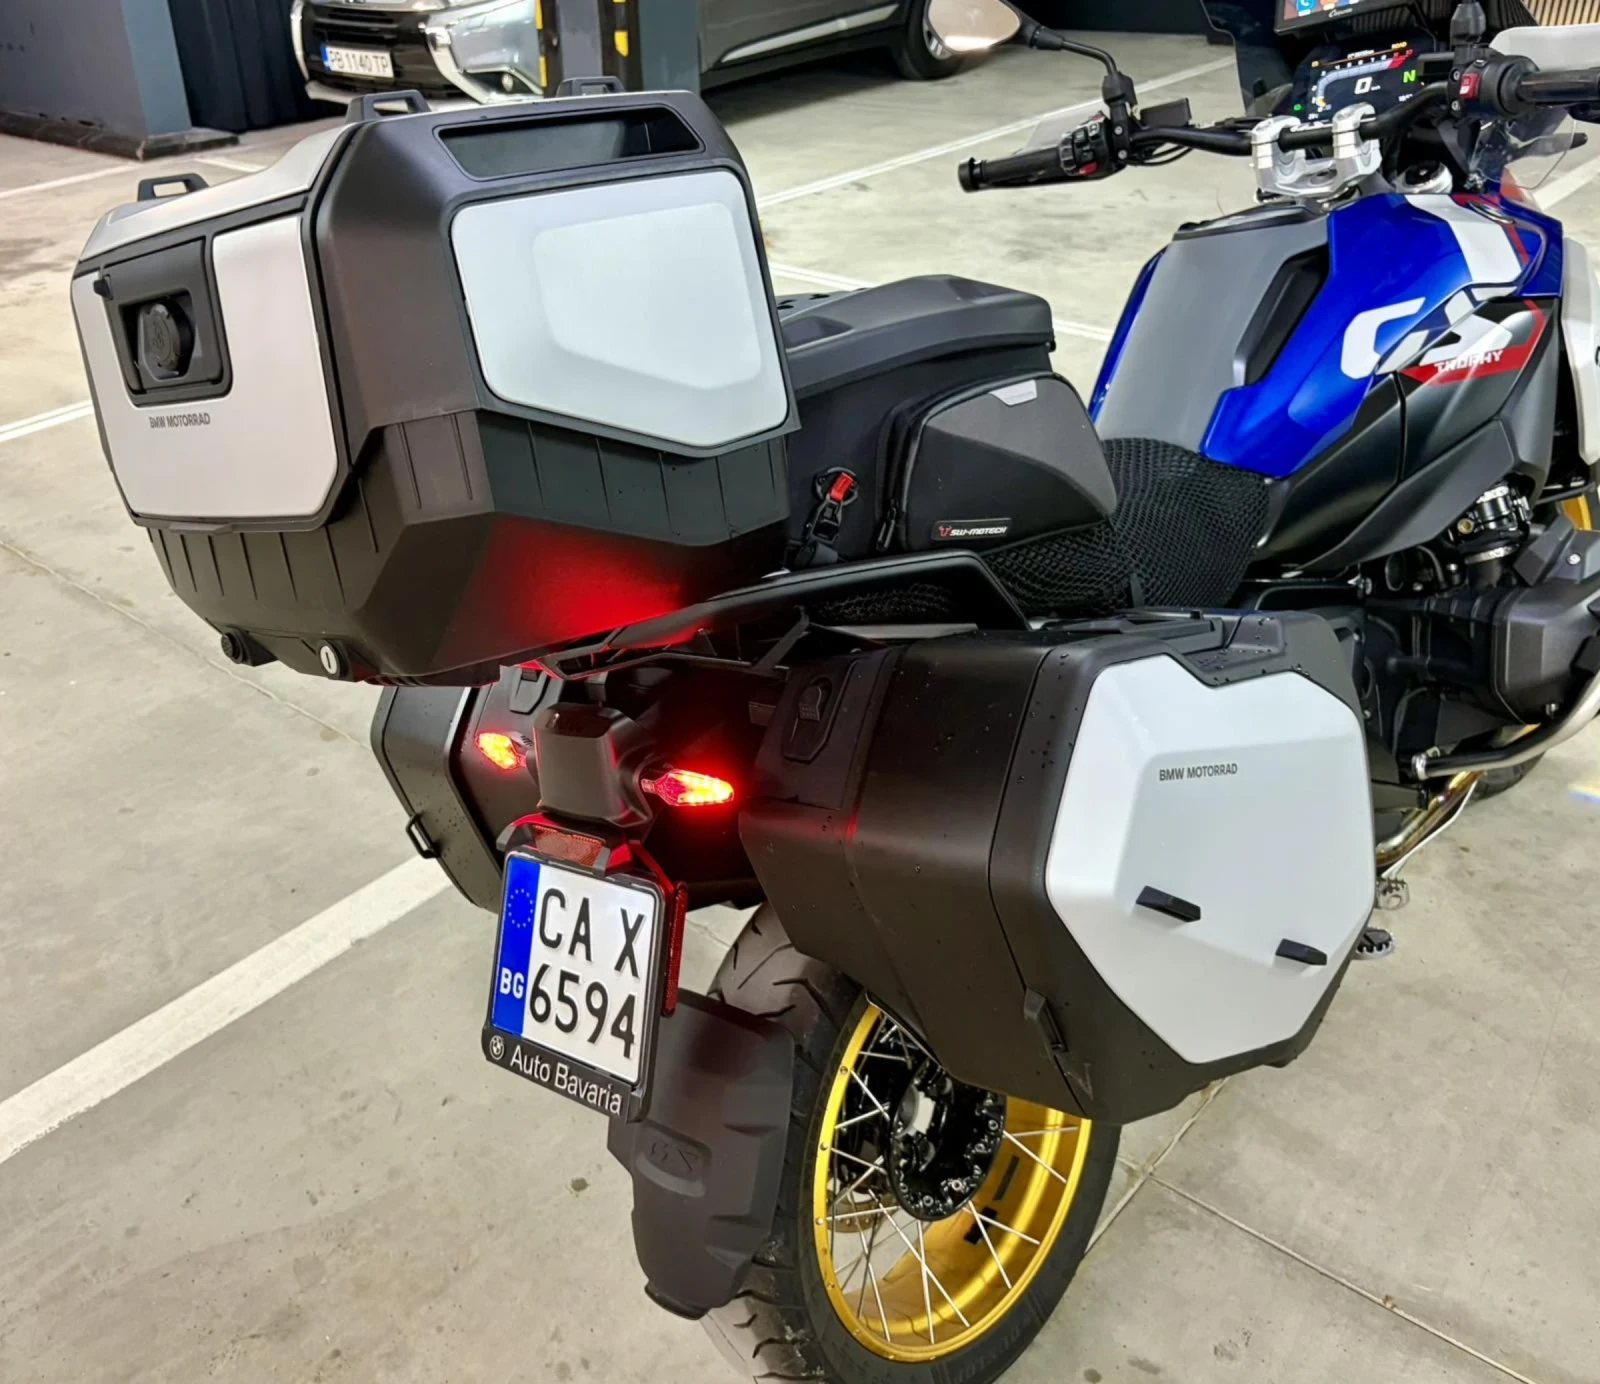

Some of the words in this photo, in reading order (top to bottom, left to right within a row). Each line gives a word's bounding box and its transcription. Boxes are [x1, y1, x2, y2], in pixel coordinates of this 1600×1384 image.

[1402, 69, 1417, 84] N
[1434, 350, 1503, 375] TROPHY
[149, 416, 166, 428] BMW
[166, 412, 211, 427] MOTORRAD
[949, 526, 1008, 537] SW-MOTECH
[1159, 768, 1185, 781] BMW
[1186, 763, 1238, 778] MOTORRAD
[538, 887, 593, 963] CA
[614, 907, 645, 979] X
[499, 966, 525, 999] BG
[528, 962, 637, 1060] 6594
[509, 1044, 552, 1083] Auto
[553, 1067, 623, 1117] Bavaria
